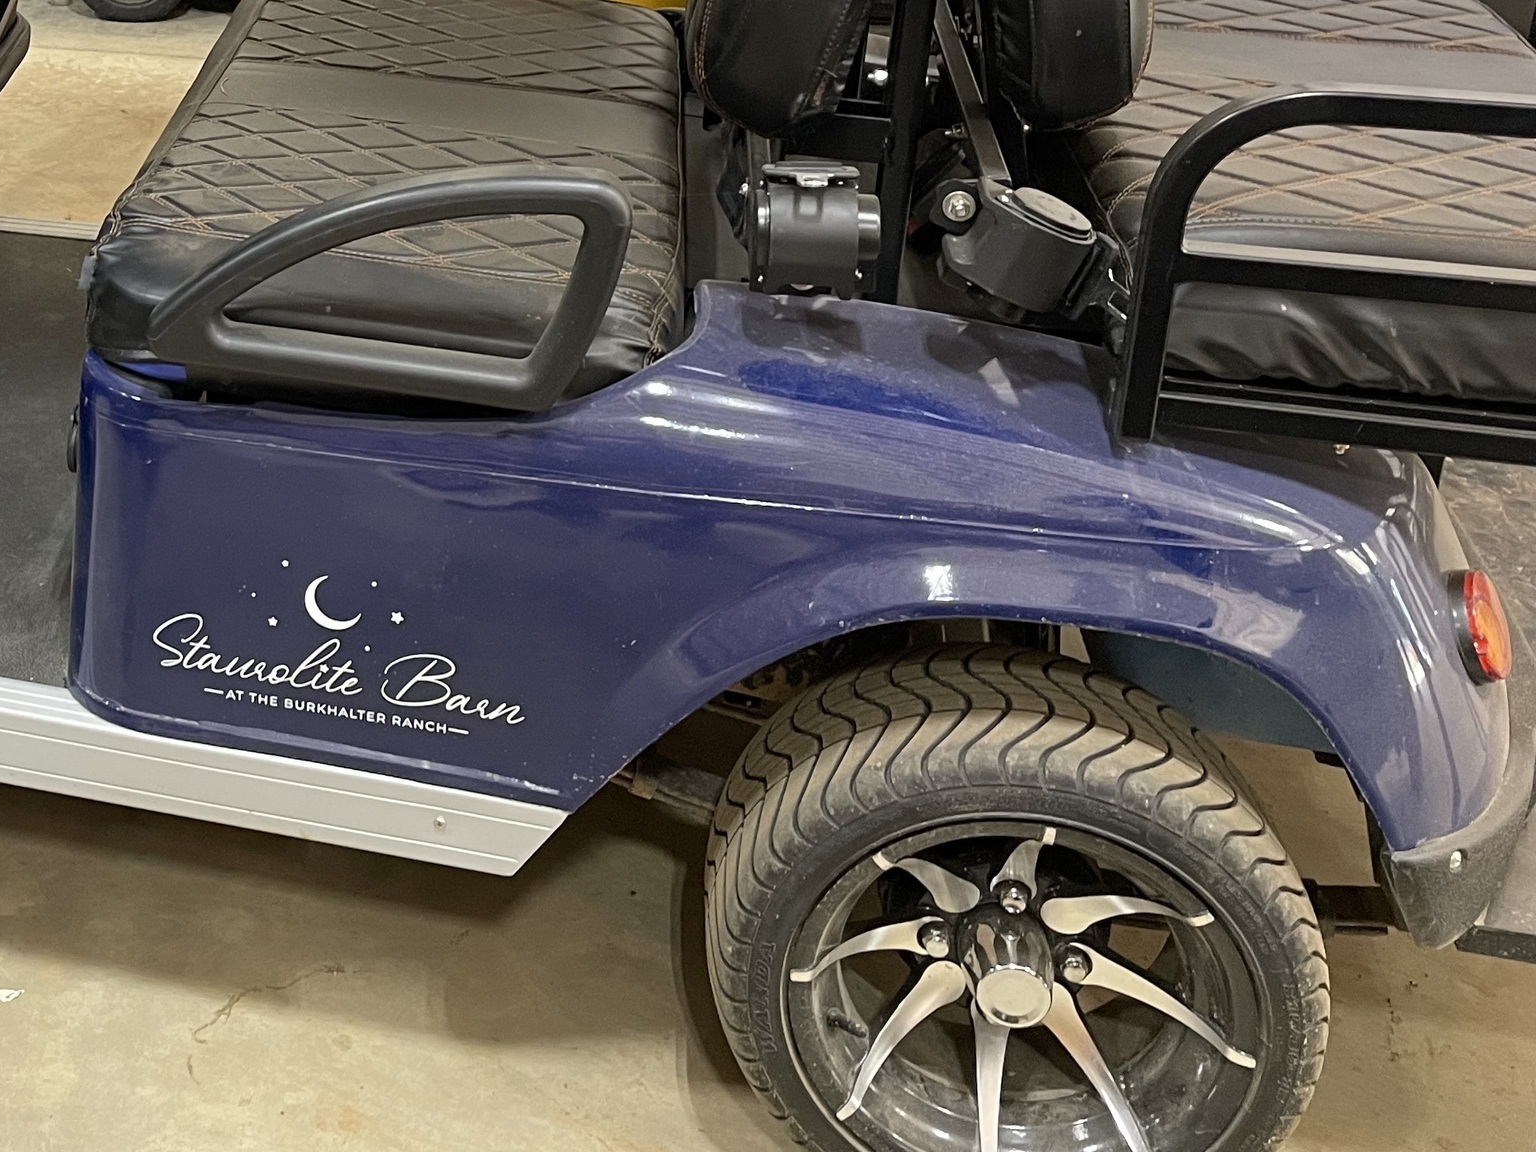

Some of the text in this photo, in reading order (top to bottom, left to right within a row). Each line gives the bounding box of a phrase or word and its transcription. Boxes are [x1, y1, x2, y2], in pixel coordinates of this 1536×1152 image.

[152, 613, 526, 726] Staurolite Barn
[224, 689, 447, 735] AT THE BURKHALTER RANCH
